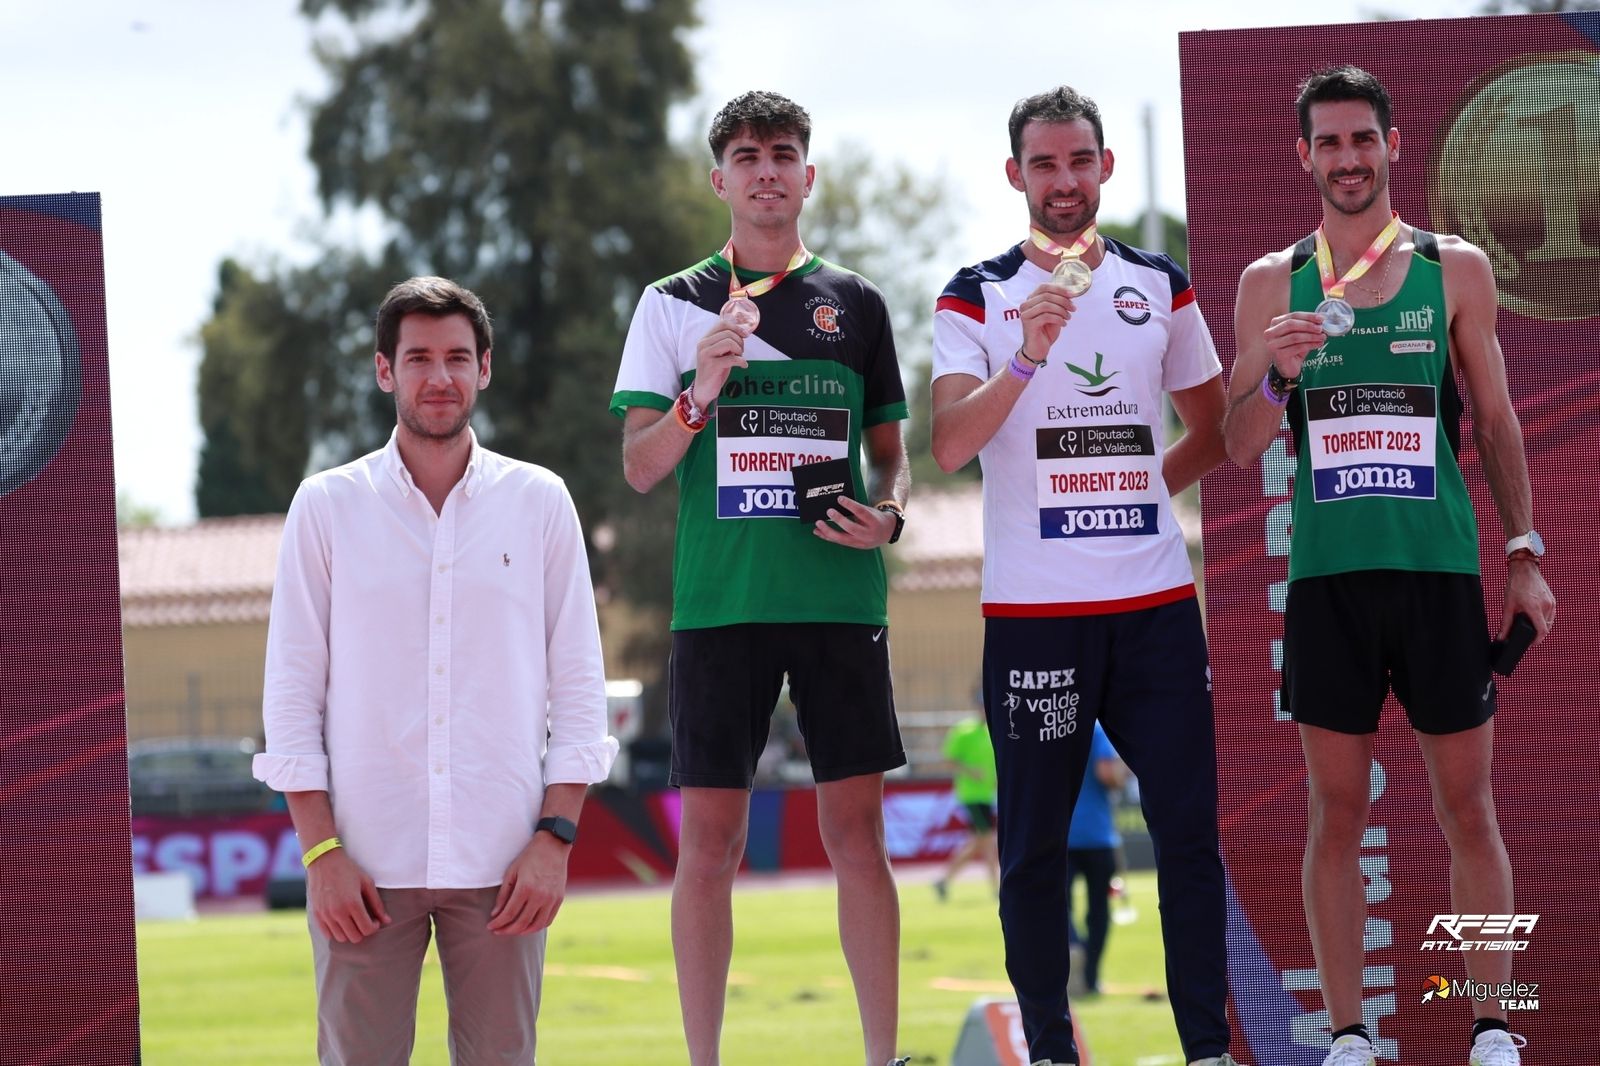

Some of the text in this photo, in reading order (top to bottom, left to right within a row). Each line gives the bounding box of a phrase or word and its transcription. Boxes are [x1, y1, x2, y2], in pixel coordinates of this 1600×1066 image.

[1119, 300, 1146, 310] CAPEX
[1352, 325, 1389, 335] FISALDE
[1356, 387, 1406, 401] Diputació
[769, 410, 818, 424] Diputació
[1047, 400, 1138, 420] Extremadura
[1356, 401, 1414, 414] de València
[769, 424, 826, 437] de València
[1088, 429, 1135, 442] Diputació
[1088, 442, 1142, 454] de València
[1322, 430, 1421, 454] TORRENT 2023
[730, 452, 832, 472] TORRENT 20
[1050, 470, 1149, 494] TORRENT 2023
[738, 487, 799, 513] Jom
[1009, 668, 1076, 690] CAPEX
[1025, 690, 1080, 712] valde
[1044, 706, 1077, 728] que
[1039, 721, 1077, 742] mao
